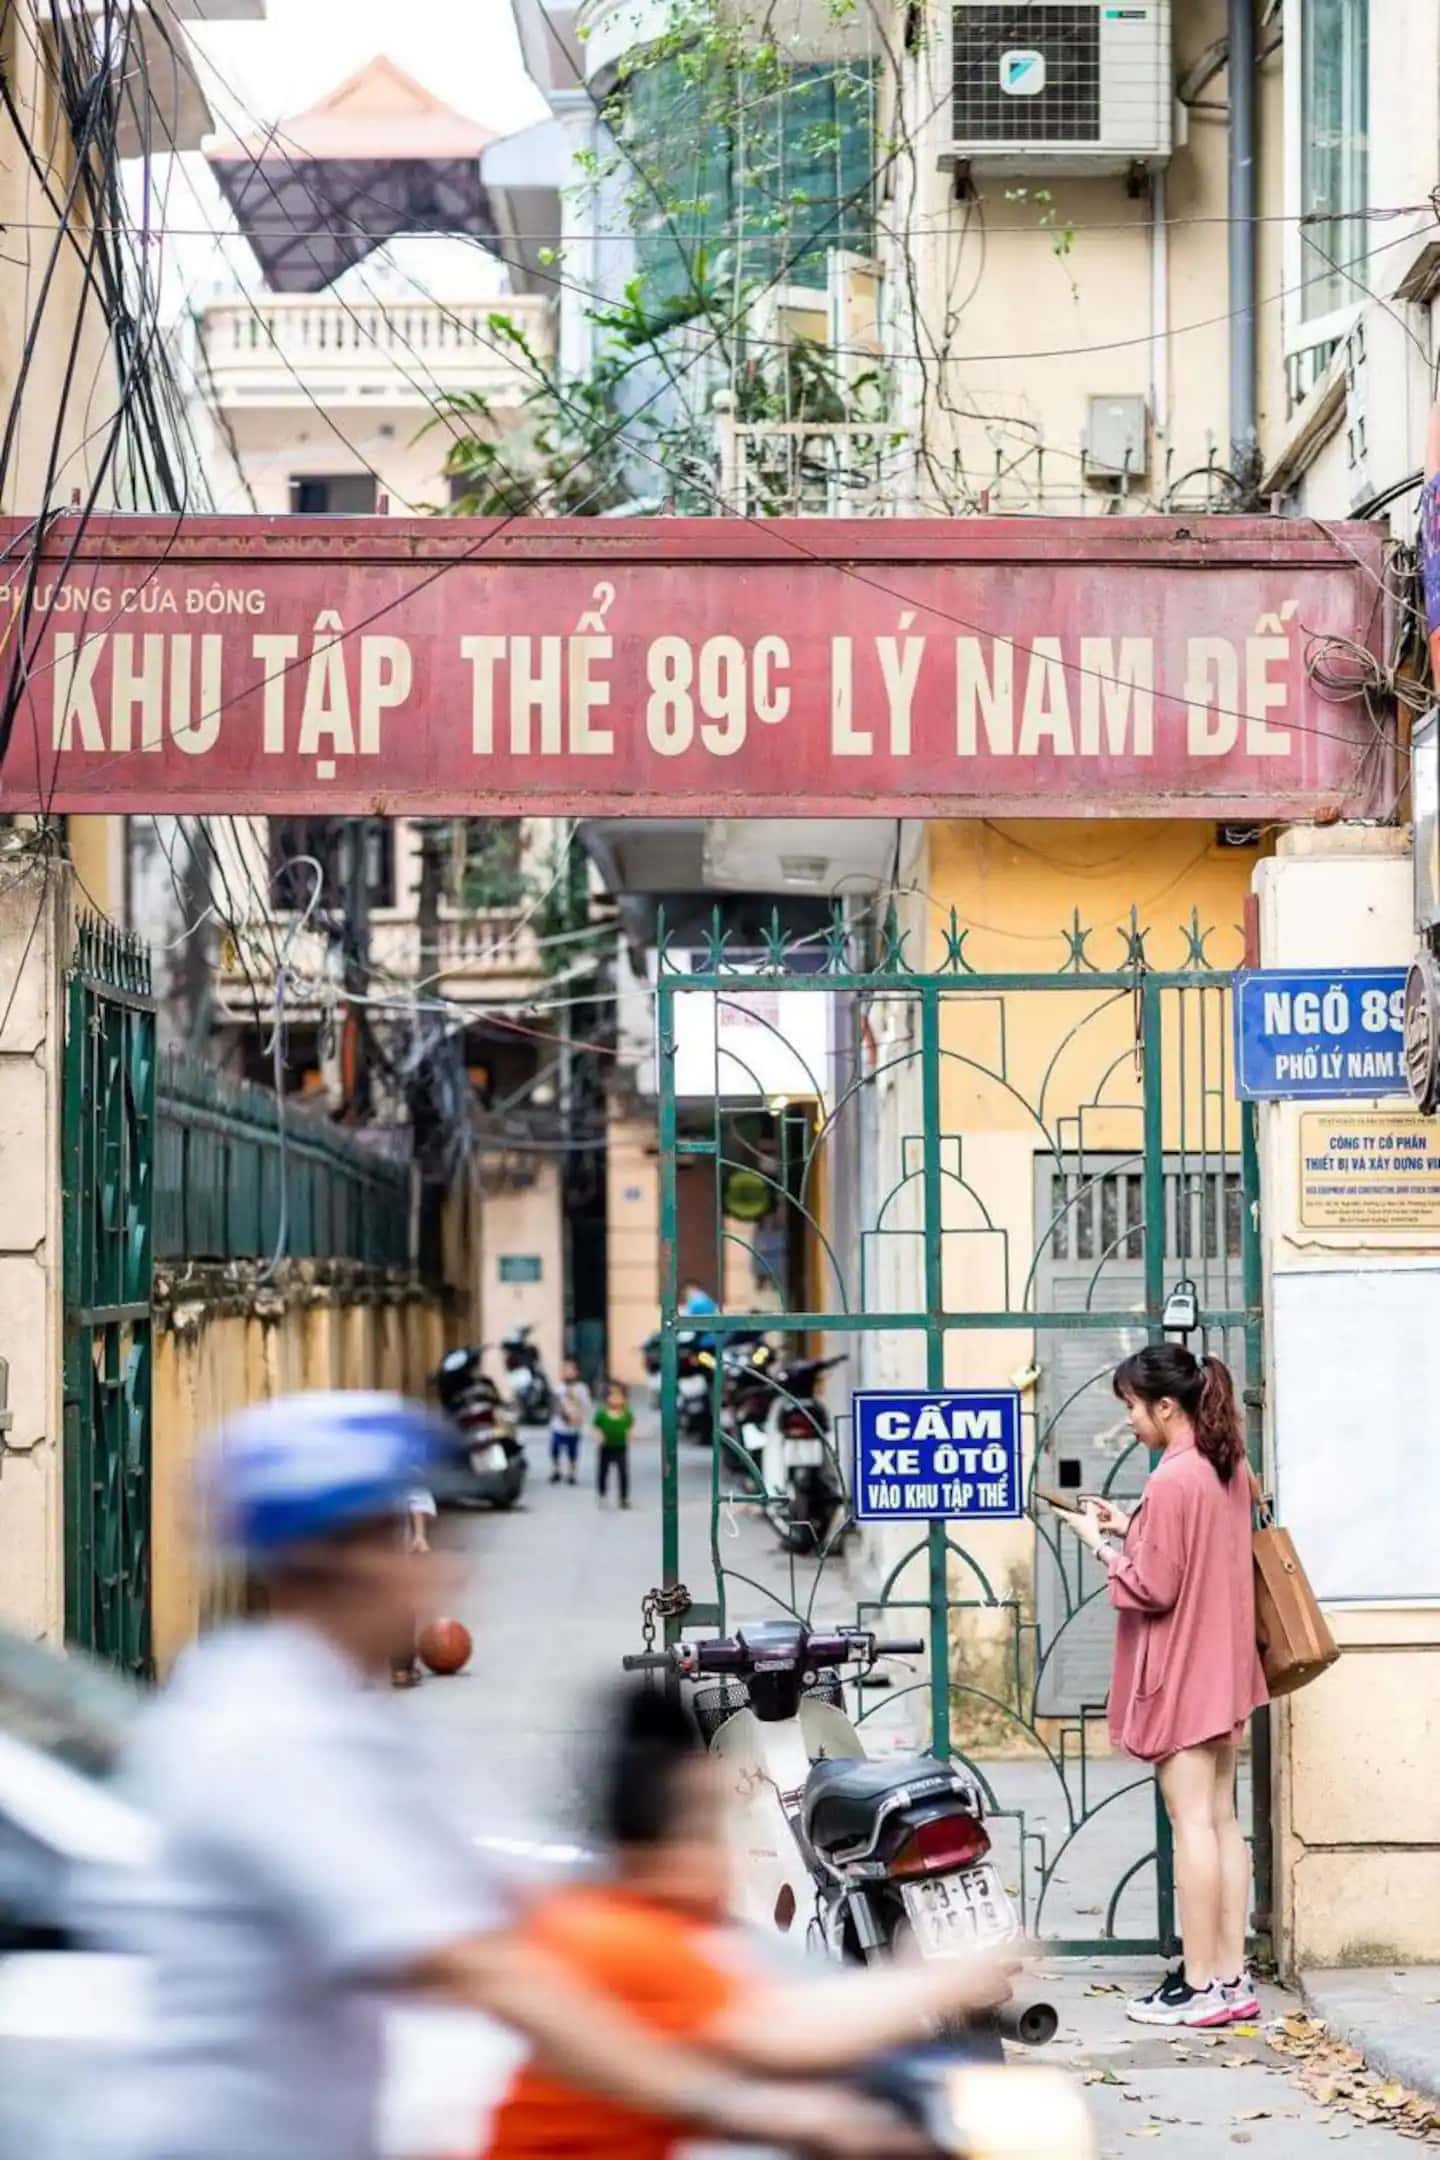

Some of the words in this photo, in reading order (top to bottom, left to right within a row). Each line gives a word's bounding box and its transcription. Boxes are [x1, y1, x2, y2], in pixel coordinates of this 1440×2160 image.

[121, 576, 178, 613] CỬA
[186, 581, 266, 614] ĐÔNG
[51, 633, 222, 754] KHU
[252, 609, 413, 780] TẬP
[461, 581, 615, 755] THỂ
[830, 611, 925, 756] LÝ
[955, 635, 1154, 756] NAM
[1184, 599, 1298, 756] ĐẾ
[1264, 985, 1349, 1035] NGÕ
[1276, 1044, 1319, 1080] PHỐ
[1321, 1044, 1344, 1080] LÝ
[1347, 1051, 1394, 1079] NAM
[1362, 1136, 1376, 1150] TY
[875, 1401, 1001, 1441] CẤM
[869, 1449, 920, 1475] XE
[933, 1443, 1007, 1474] ÔTÔ
[868, 1478, 900, 1509] VÀO
[904, 1484, 939, 1507] KHU
[942, 1477, 974, 1512] TẬP
[977, 1472, 1009, 1507] THỂ
